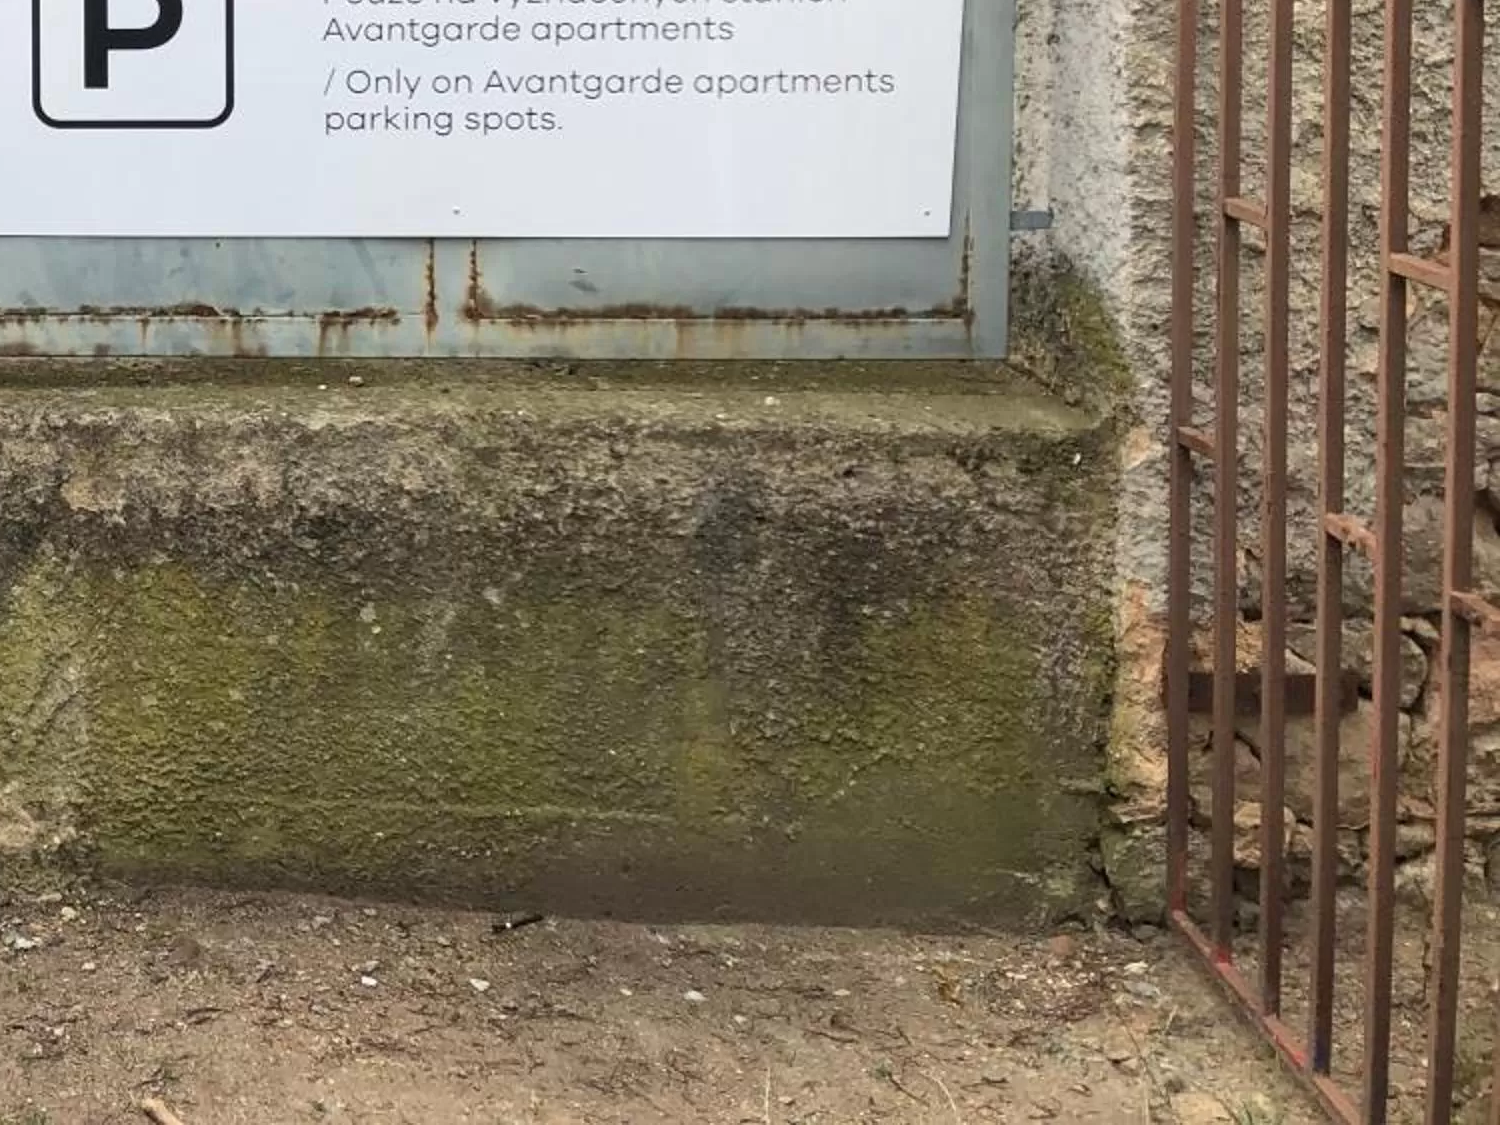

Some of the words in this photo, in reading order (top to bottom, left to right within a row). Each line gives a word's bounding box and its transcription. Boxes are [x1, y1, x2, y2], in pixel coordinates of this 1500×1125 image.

[322, 16, 521, 48] Avantgarde
[531, 16, 735, 47] apartments
[323, 68, 336, 97] /
[345, 67, 422, 100] Only
[431, 74, 473, 95] on
[483, 67, 684, 100] Avantgarde
[693, 67, 896, 99] apartments
[324, 105, 453, 139] parking
[464, 106, 563, 137] spots.
